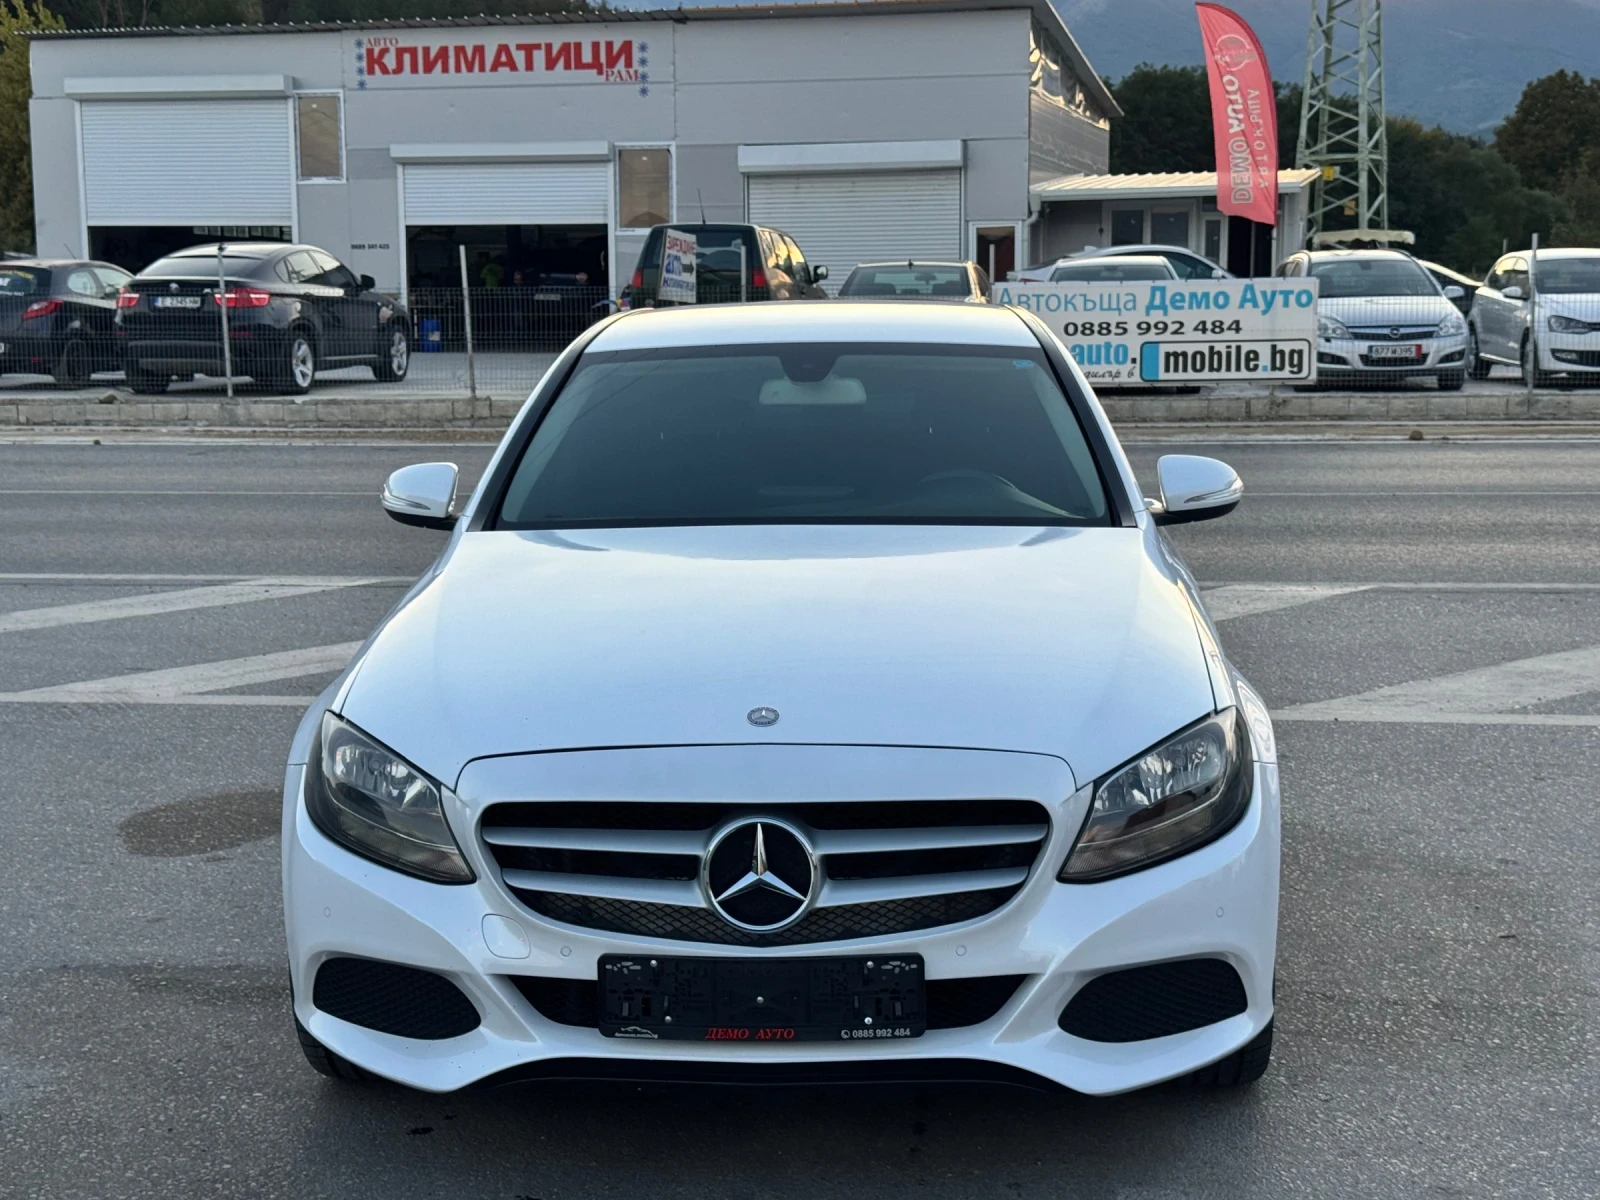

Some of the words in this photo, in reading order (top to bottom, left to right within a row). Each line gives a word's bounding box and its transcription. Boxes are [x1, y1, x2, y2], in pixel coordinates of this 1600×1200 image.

[366, 37, 399, 48] АВТО
[365, 40, 634, 76] КЛИМАТИЦИ
[604, 69, 639, 82] РАМ
[999, 287, 1137, 316] Автокъща
[1144, 285, 1231, 316] Демо
[1238, 284, 1314, 316] Ауто
[1063, 321, 1128, 337] 0885
[1136, 320, 1186, 336] 992
[1193, 319, 1243, 335] 484
[1163, 344, 1304, 376] mobile.bg
[704, 1027, 749, 1040] ДЕМО
[755, 1027, 795, 1039] АУТО
[852, 1029, 874, 1038] 0885
[876, 1028, 892, 1037] 992
[894, 1028, 910, 1037] 484
